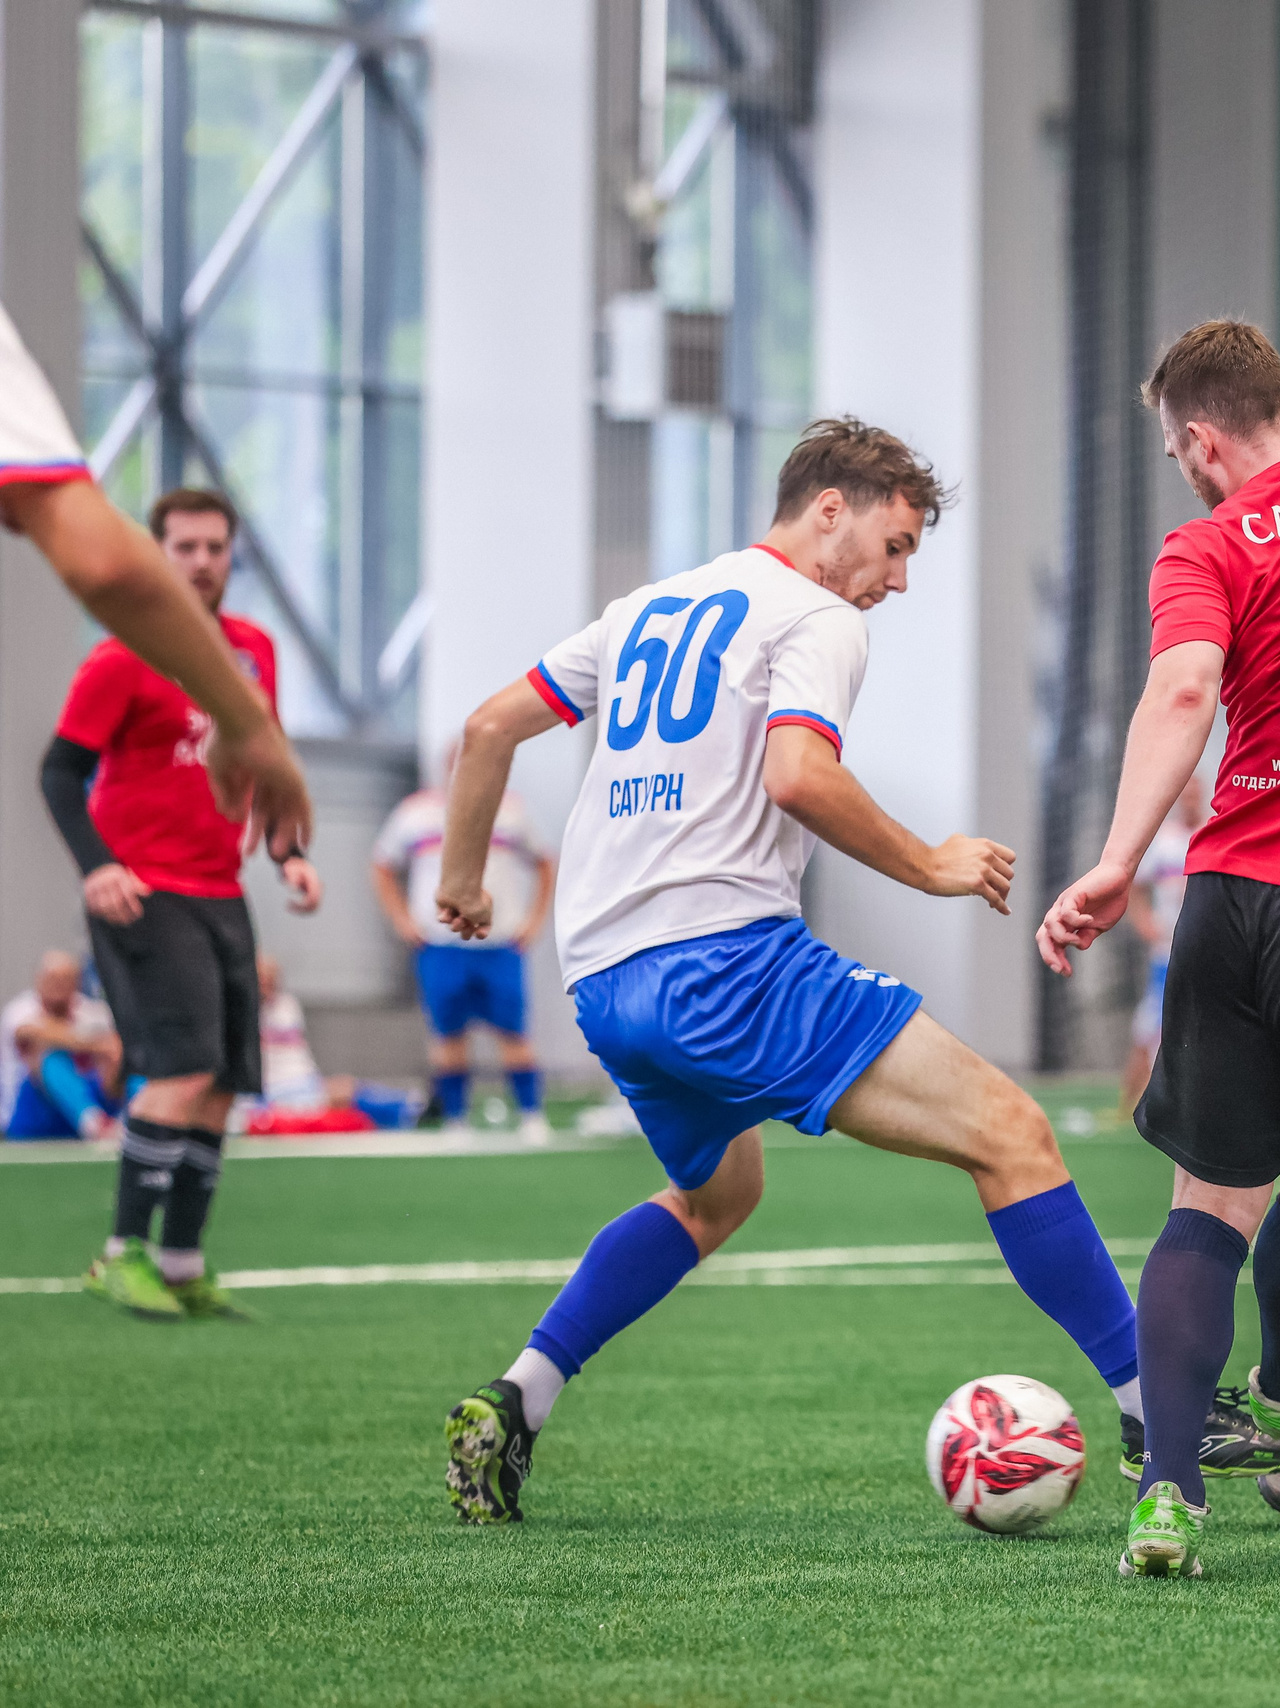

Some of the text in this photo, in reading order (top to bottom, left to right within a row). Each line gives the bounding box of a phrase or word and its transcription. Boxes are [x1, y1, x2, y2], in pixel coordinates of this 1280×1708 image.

[607, 588, 750, 752] 50
[609, 772, 684, 819] САТУРН
[1143, 1521, 1180, 1534] COPA
